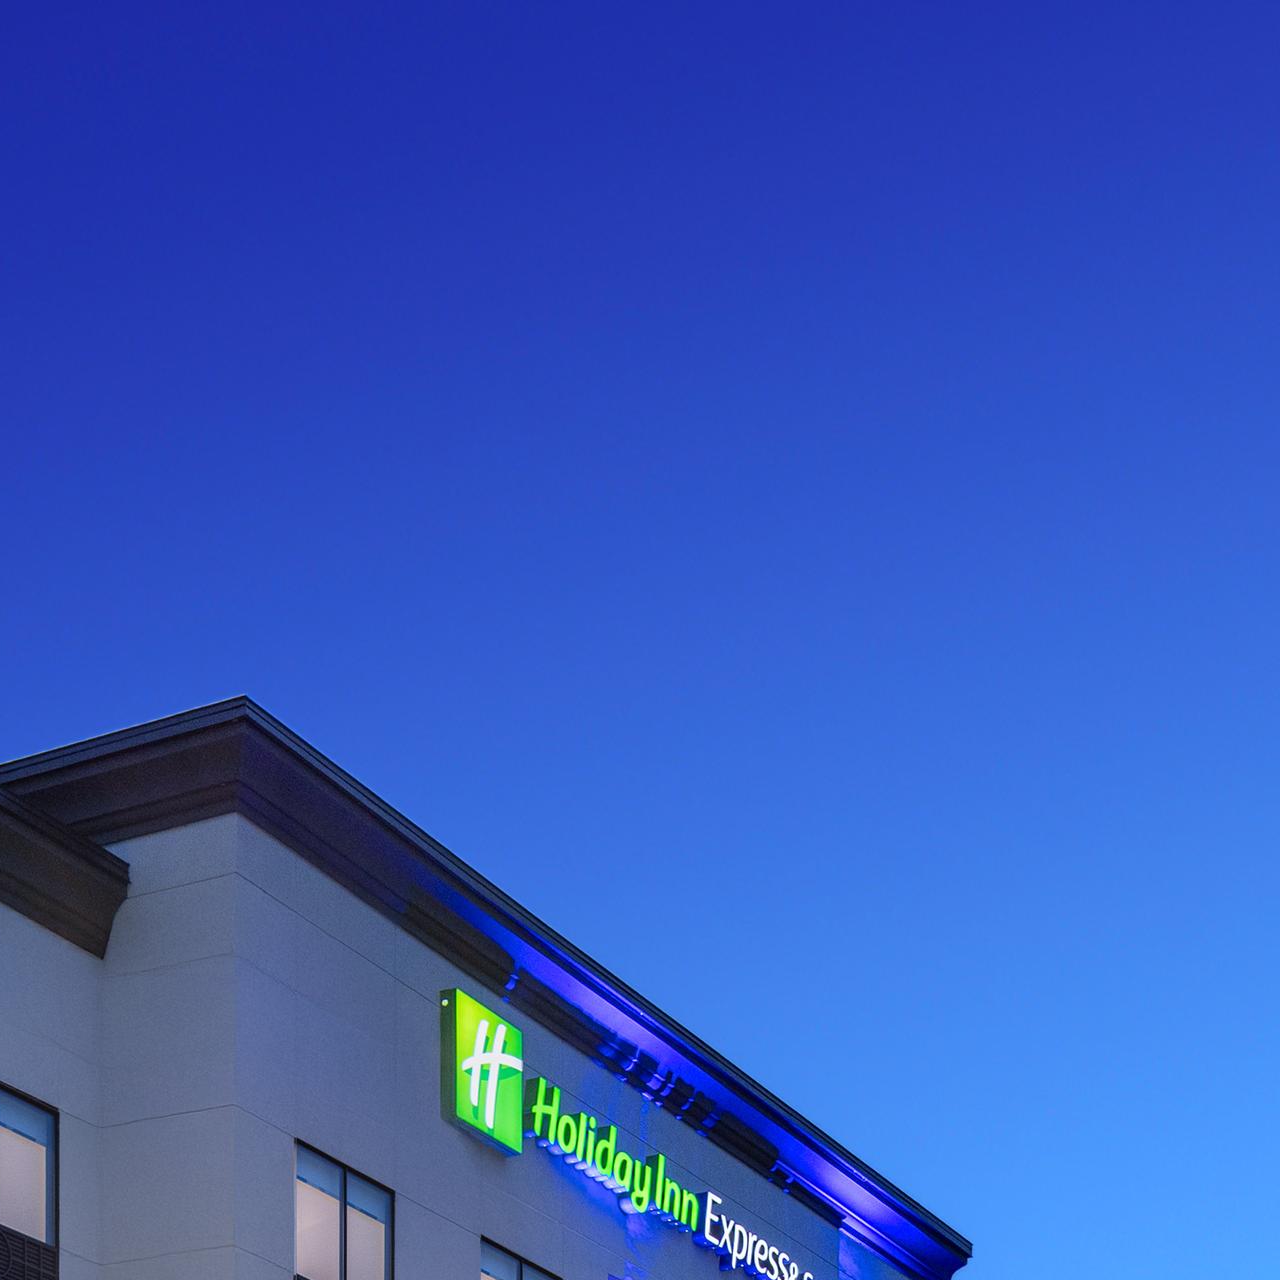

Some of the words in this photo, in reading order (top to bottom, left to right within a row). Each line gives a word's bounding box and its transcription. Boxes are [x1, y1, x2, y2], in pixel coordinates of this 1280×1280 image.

[461, 1019, 523, 1129] H
[532, 1076, 651, 1213] Holiday
[655, 1153, 699, 1231] Inn
